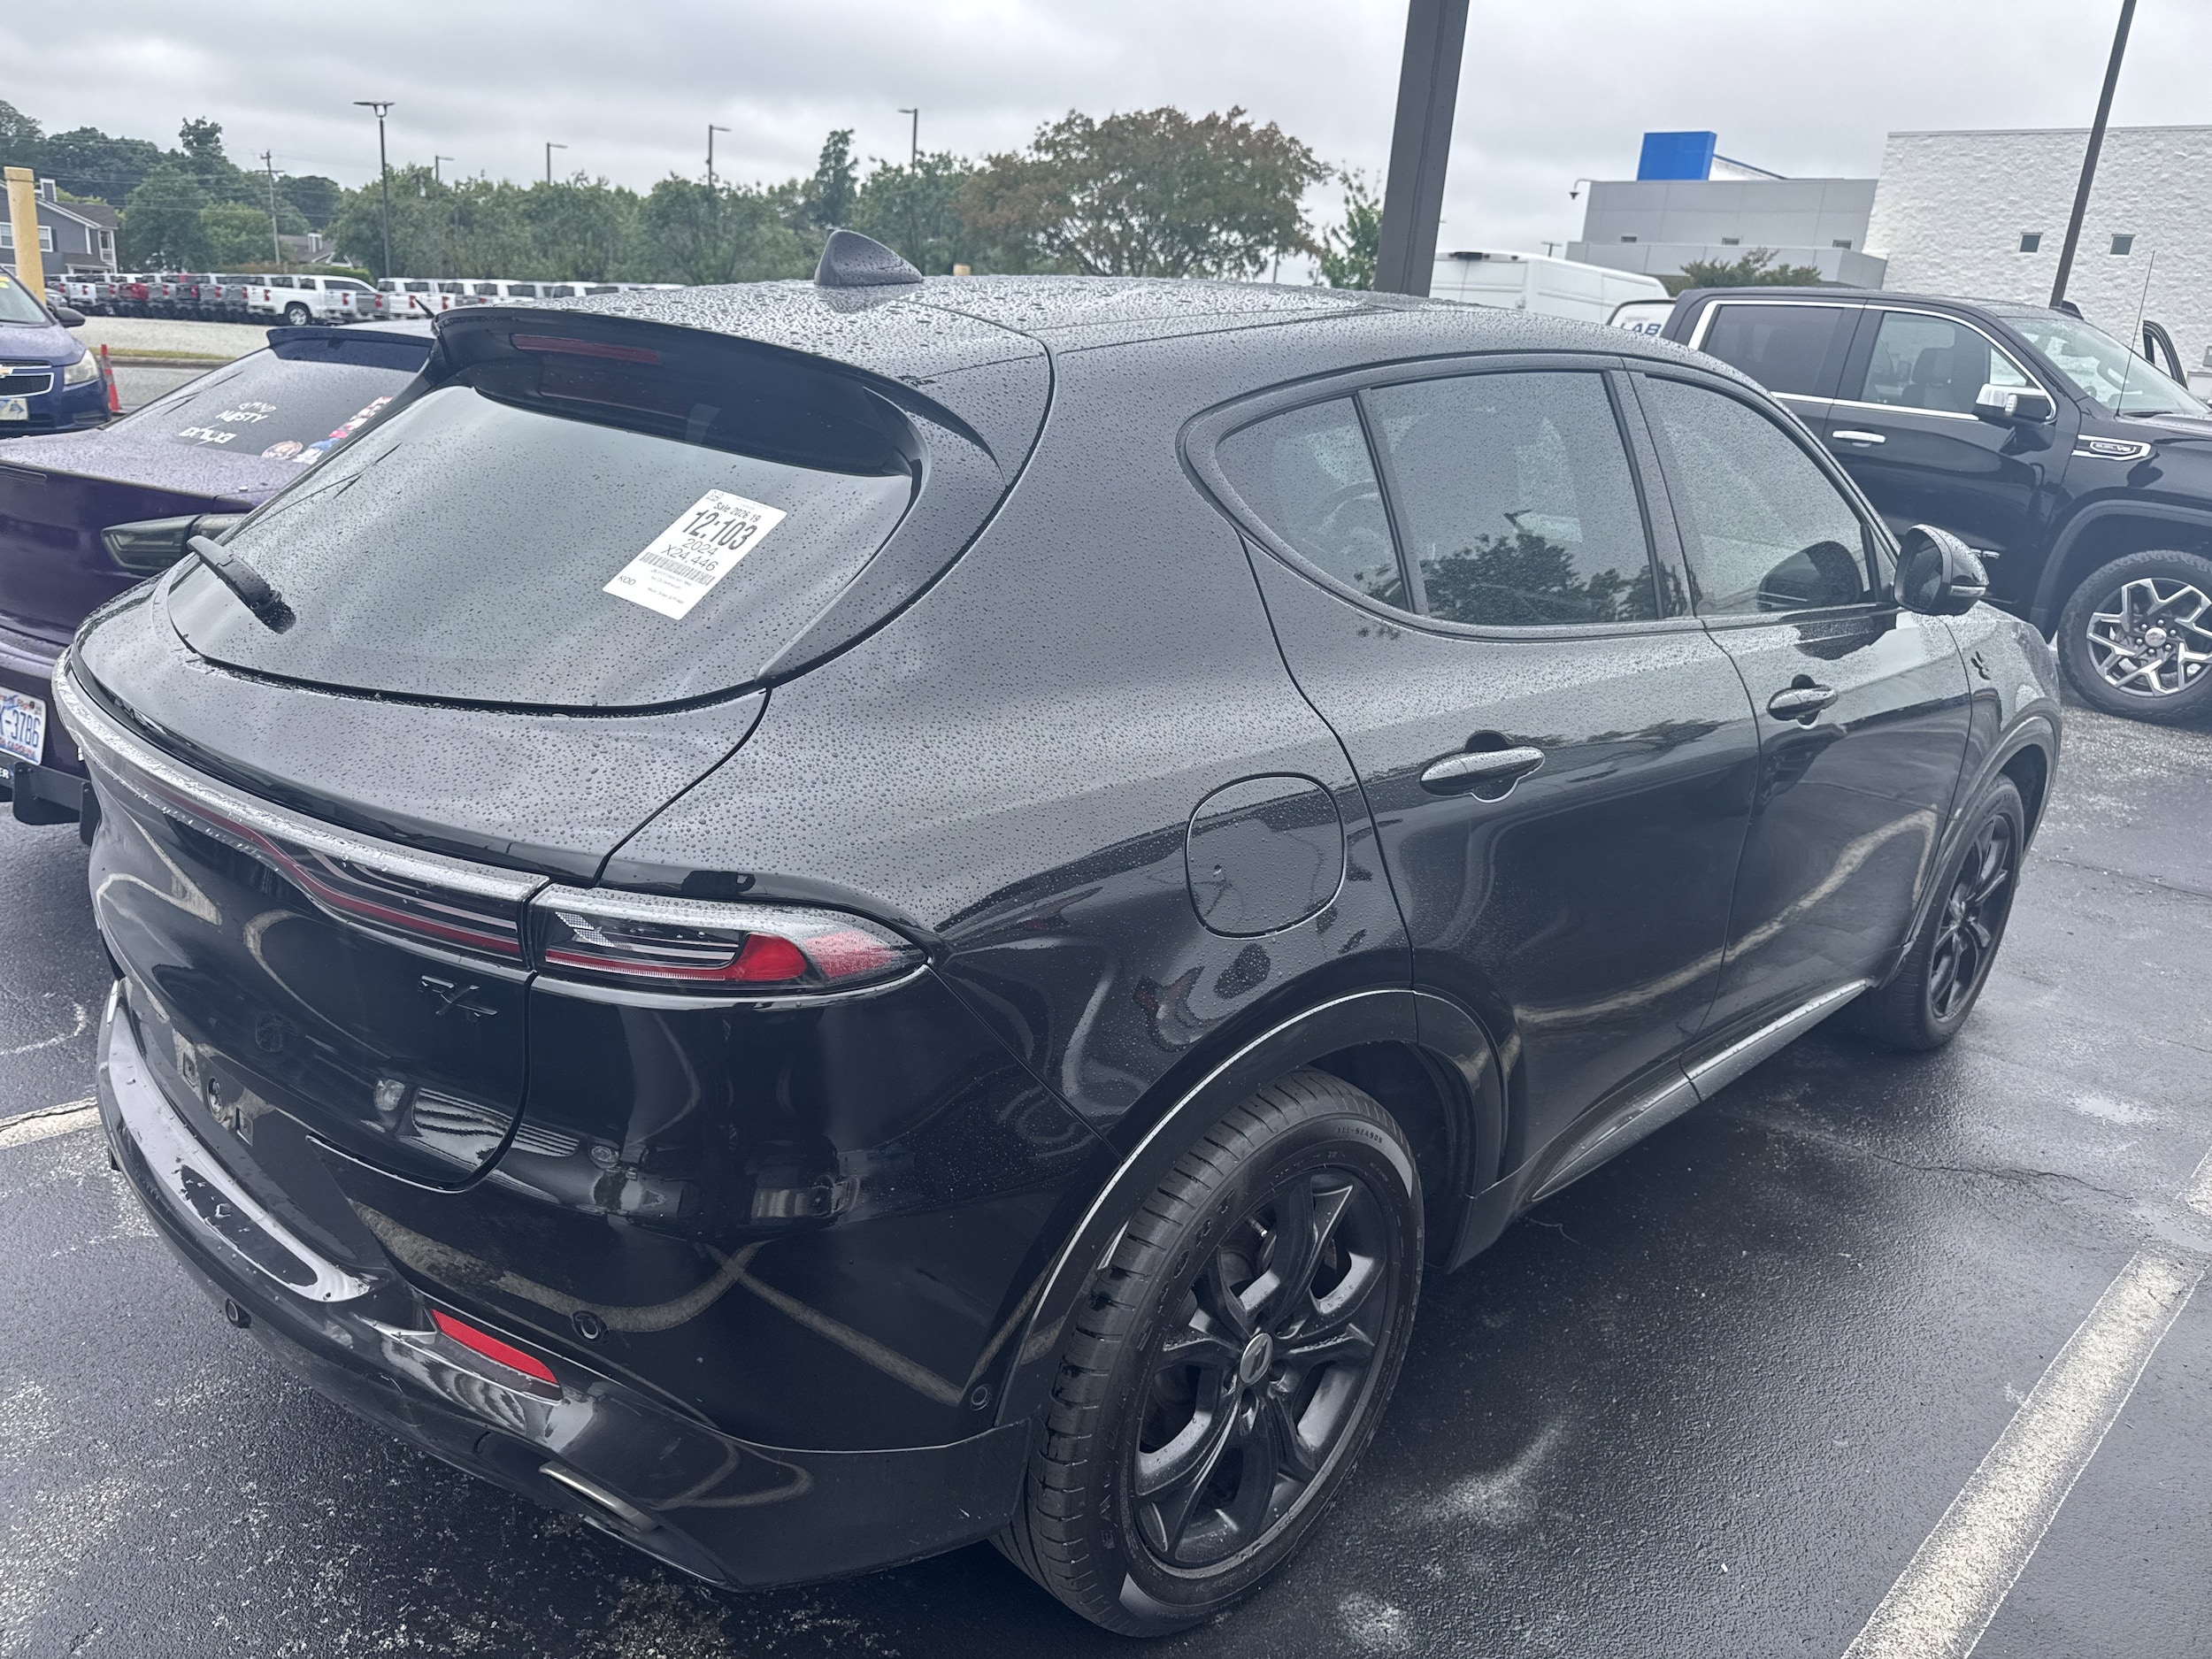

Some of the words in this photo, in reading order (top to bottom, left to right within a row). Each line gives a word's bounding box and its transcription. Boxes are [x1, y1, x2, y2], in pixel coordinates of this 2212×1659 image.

[713, 502, 731, 512] Sale
[730, 507, 751, 519] 2026
[749, 514, 762, 523] 19
[681, 509, 757, 550] 12:103
[681, 538, 719, 557] 2024
[1337, 1126, 1384, 1144] ALL-SEASON
